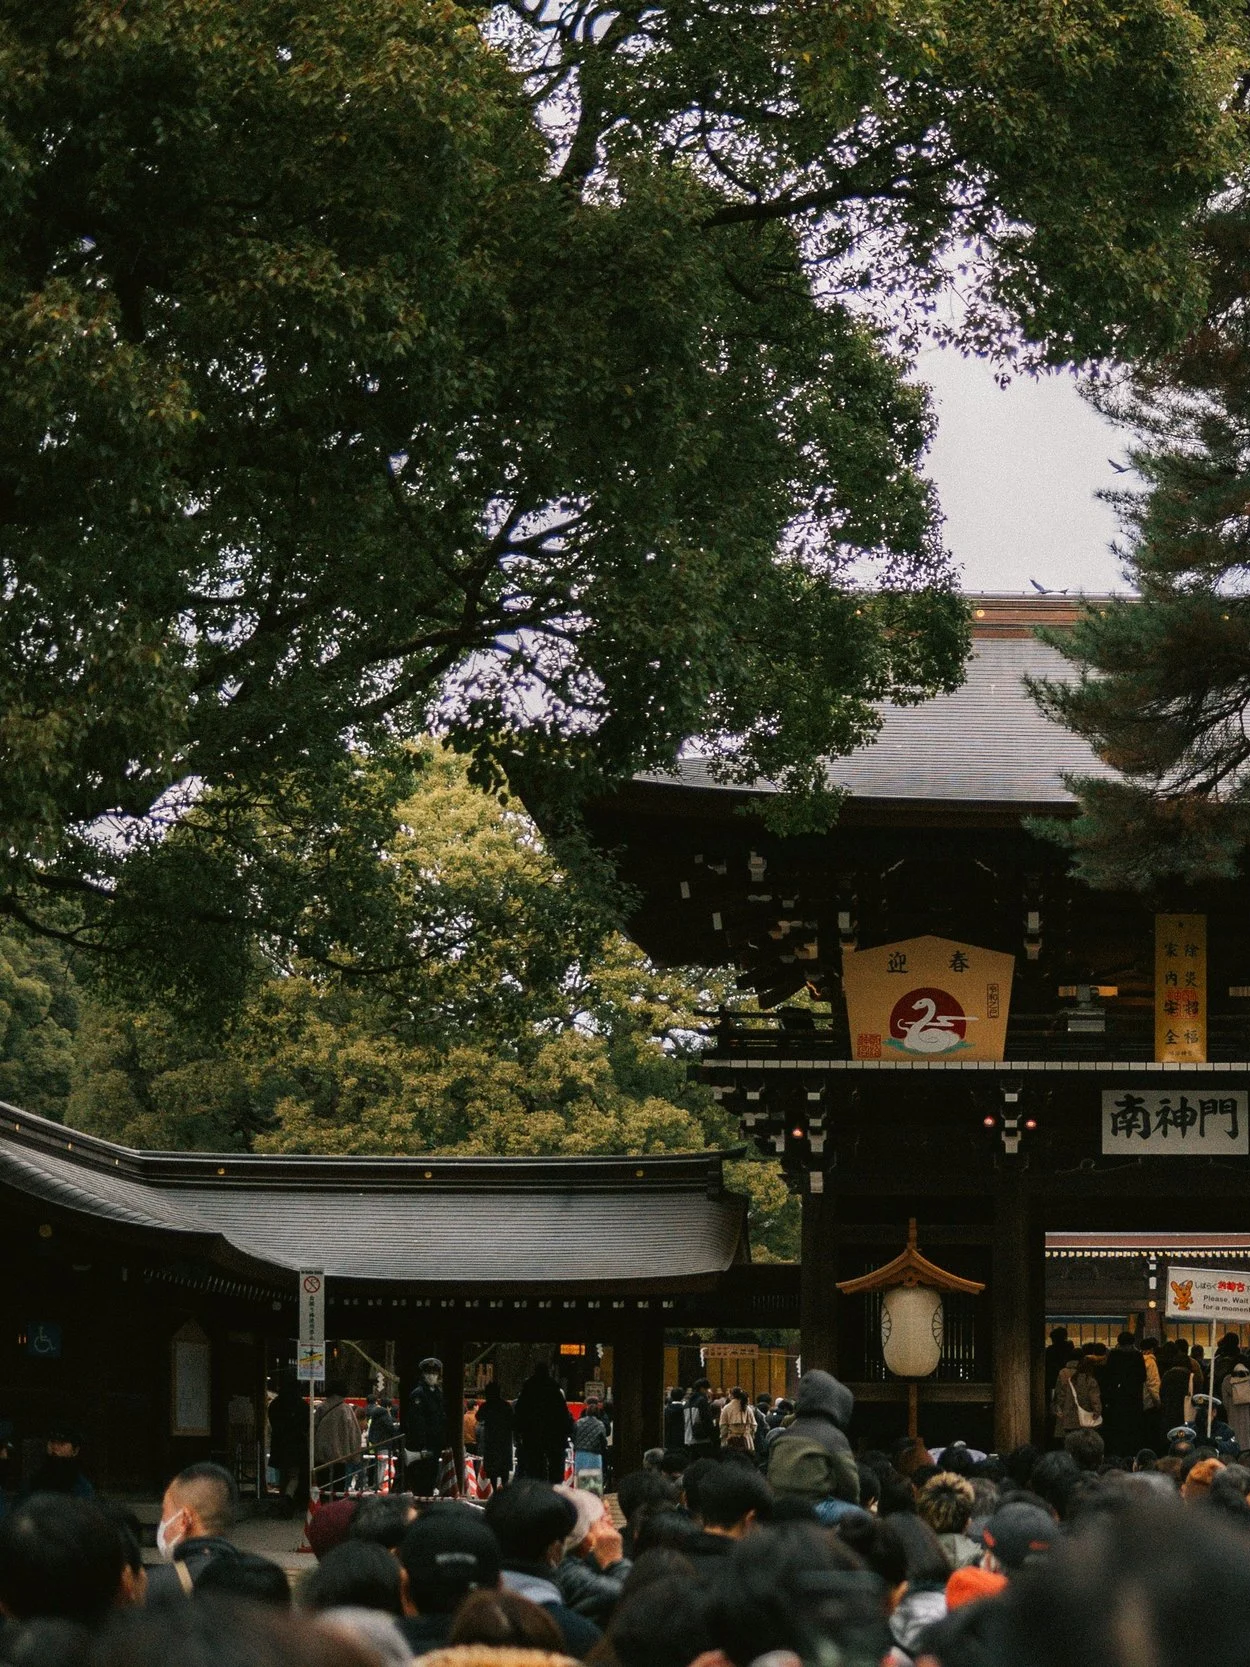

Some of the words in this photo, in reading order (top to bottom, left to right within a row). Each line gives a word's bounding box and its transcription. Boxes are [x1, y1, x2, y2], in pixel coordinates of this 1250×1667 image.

[887, 951, 970, 974] 迎春
[1163, 943, 1180, 1045] 家内安全
[1110, 1093, 1239, 1140] 南神門
[1232, 1296, 1249, 1304] Wait
